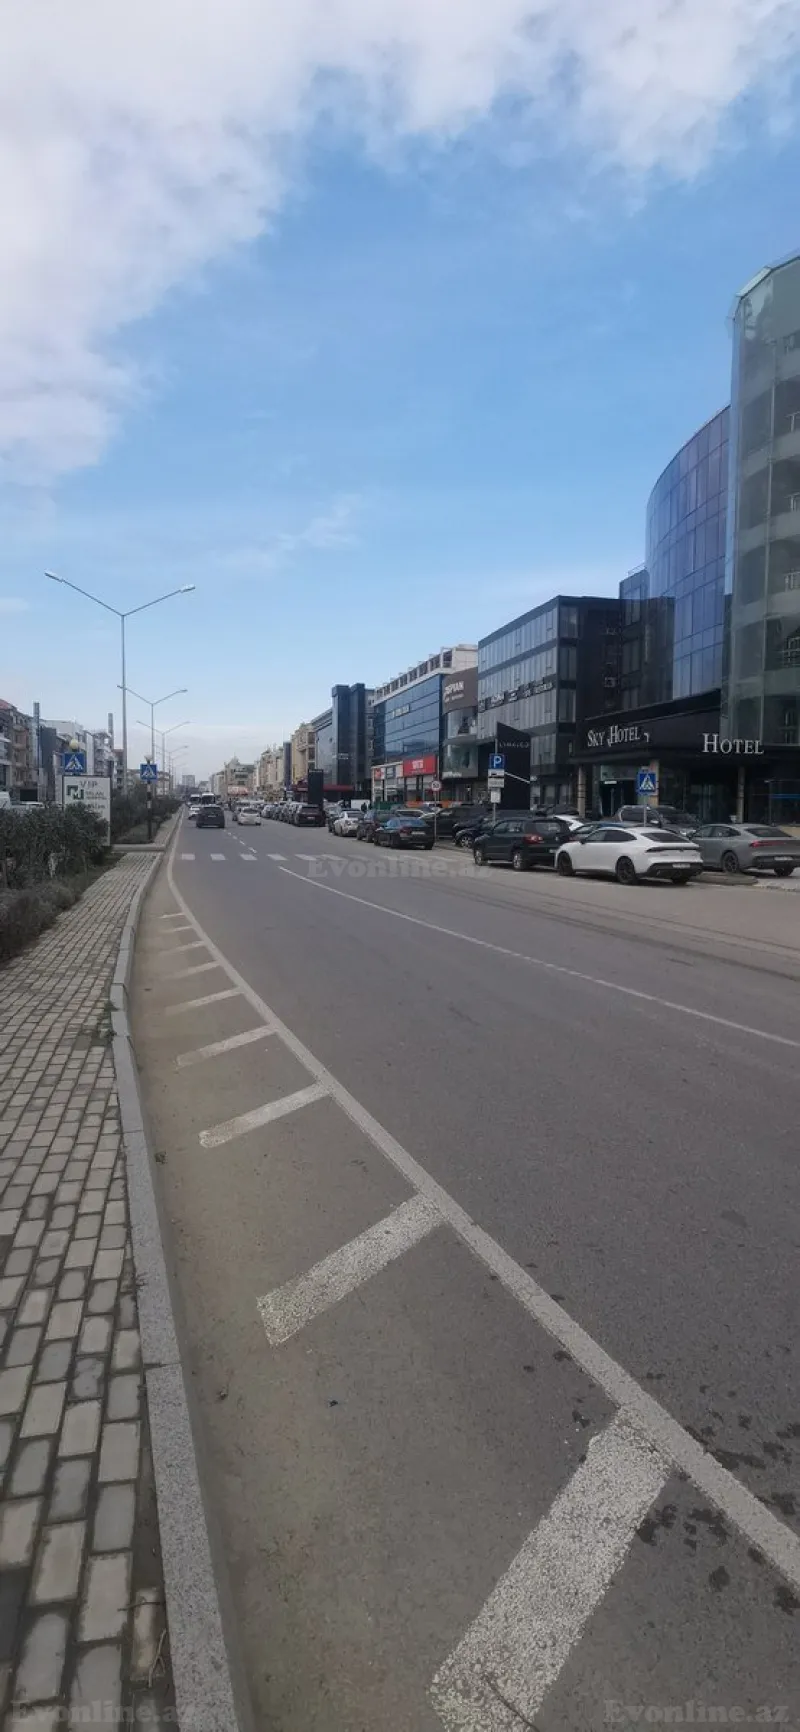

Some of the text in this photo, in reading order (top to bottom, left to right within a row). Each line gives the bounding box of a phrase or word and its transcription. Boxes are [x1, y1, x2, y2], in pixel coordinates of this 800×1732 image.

[608, 725, 641, 746] HOTEL
[702, 733, 764, 754] HOTEL
[494, 755, 502, 768] P
[80, 780, 98, 788] VIP
